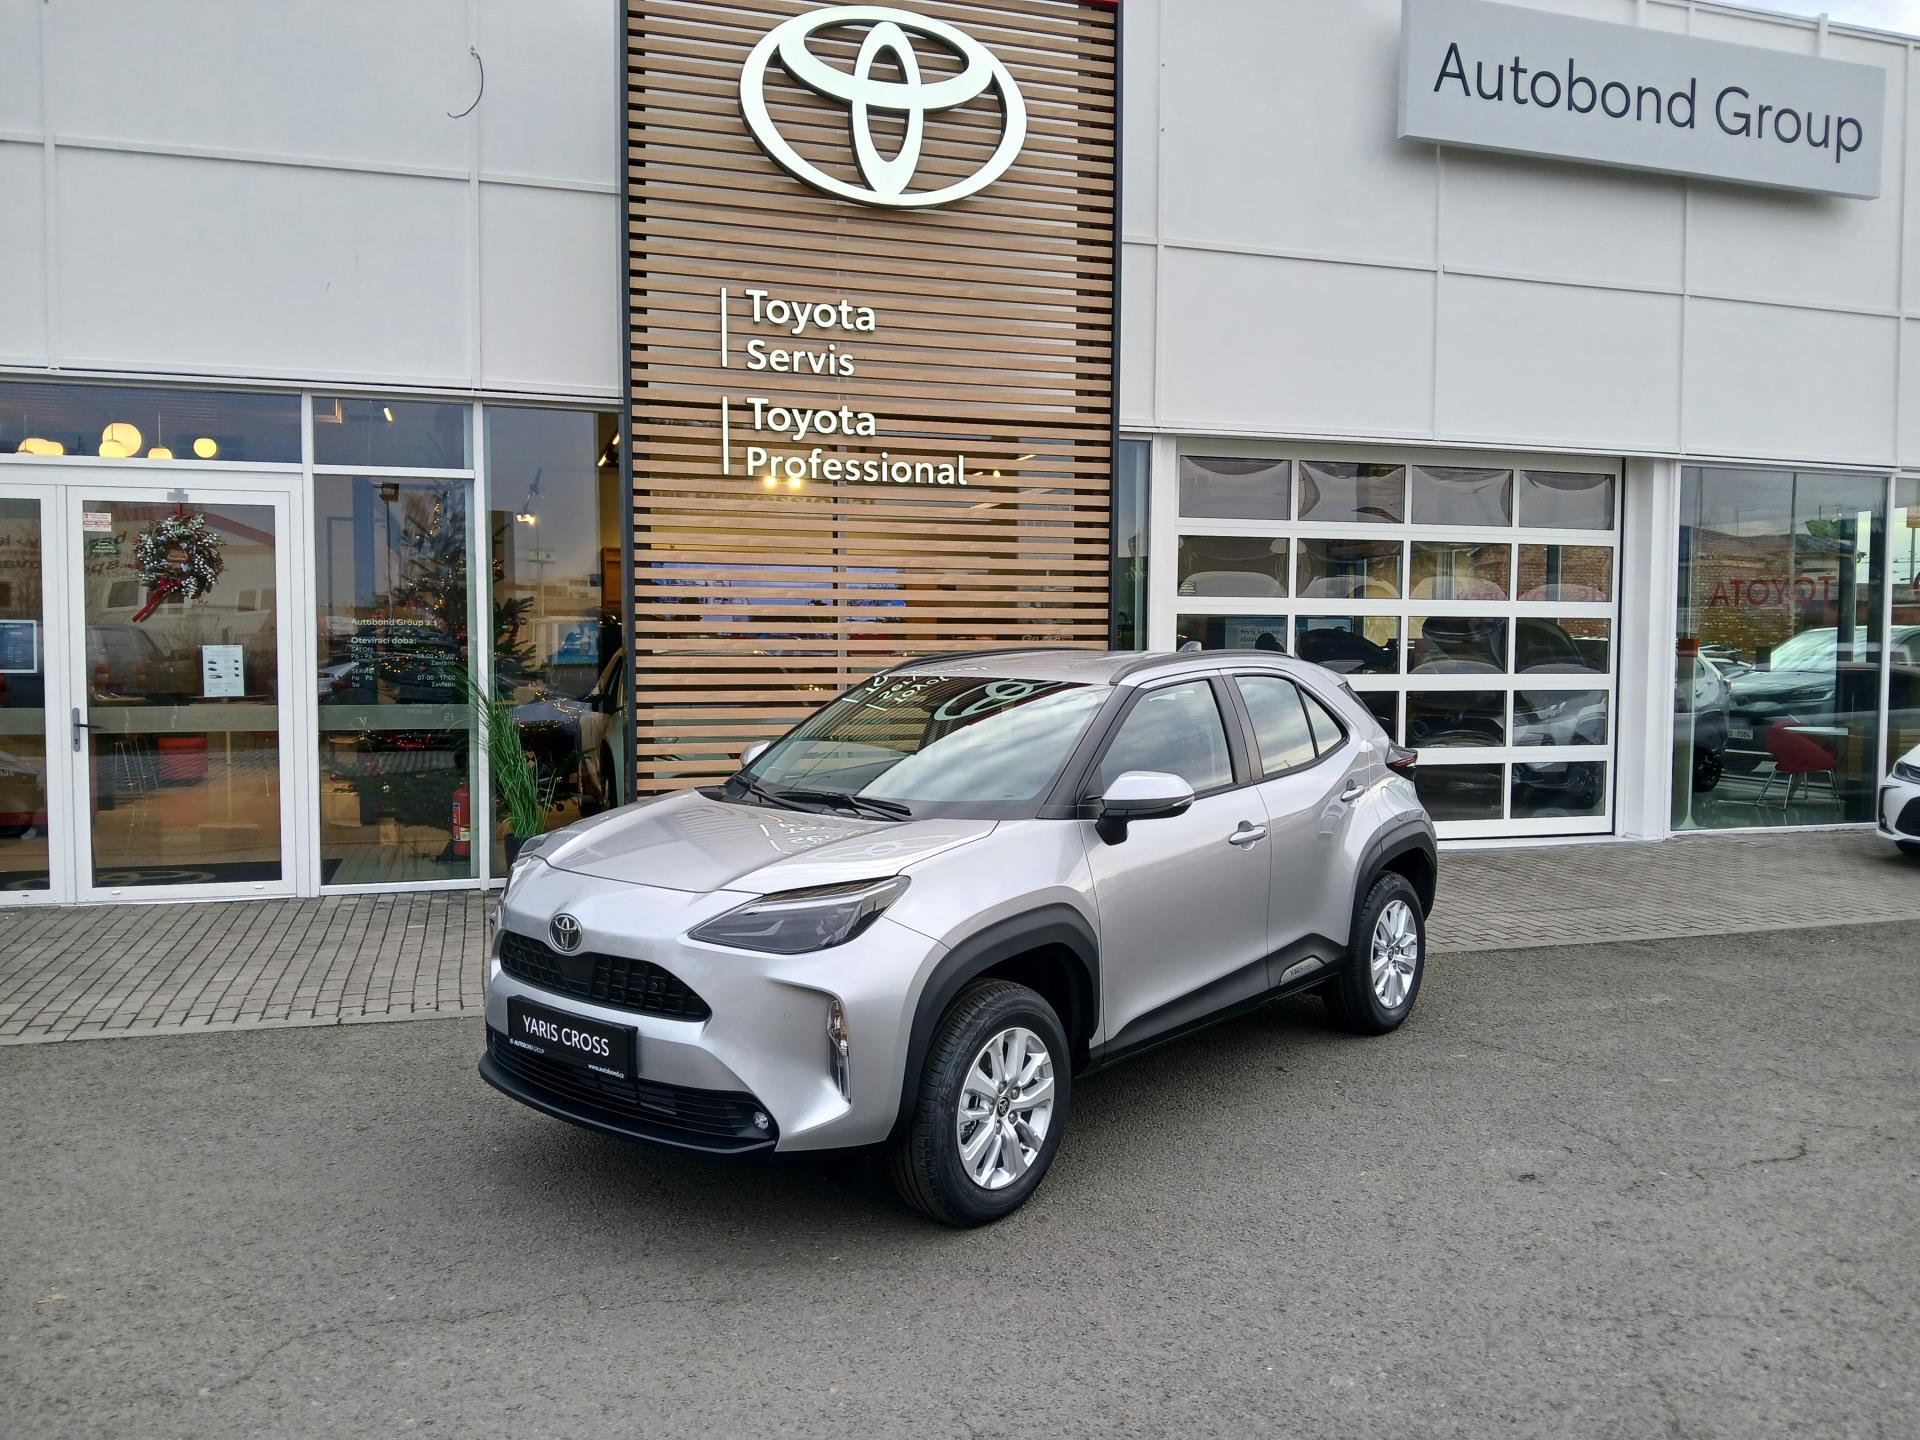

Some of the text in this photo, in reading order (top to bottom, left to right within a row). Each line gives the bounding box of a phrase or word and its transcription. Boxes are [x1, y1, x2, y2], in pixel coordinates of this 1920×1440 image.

[1433, 41, 1863, 163] Autobond Group
[745, 289, 876, 335] Toyota
[746, 339, 855, 376] Servis
[746, 397, 876, 441] Toyota
[746, 446, 968, 486] Professional
[351, 618, 395, 626] Autobond
[396, 618, 424, 627] Group
[522, 1014, 610, 1057] YARIS CROSS
